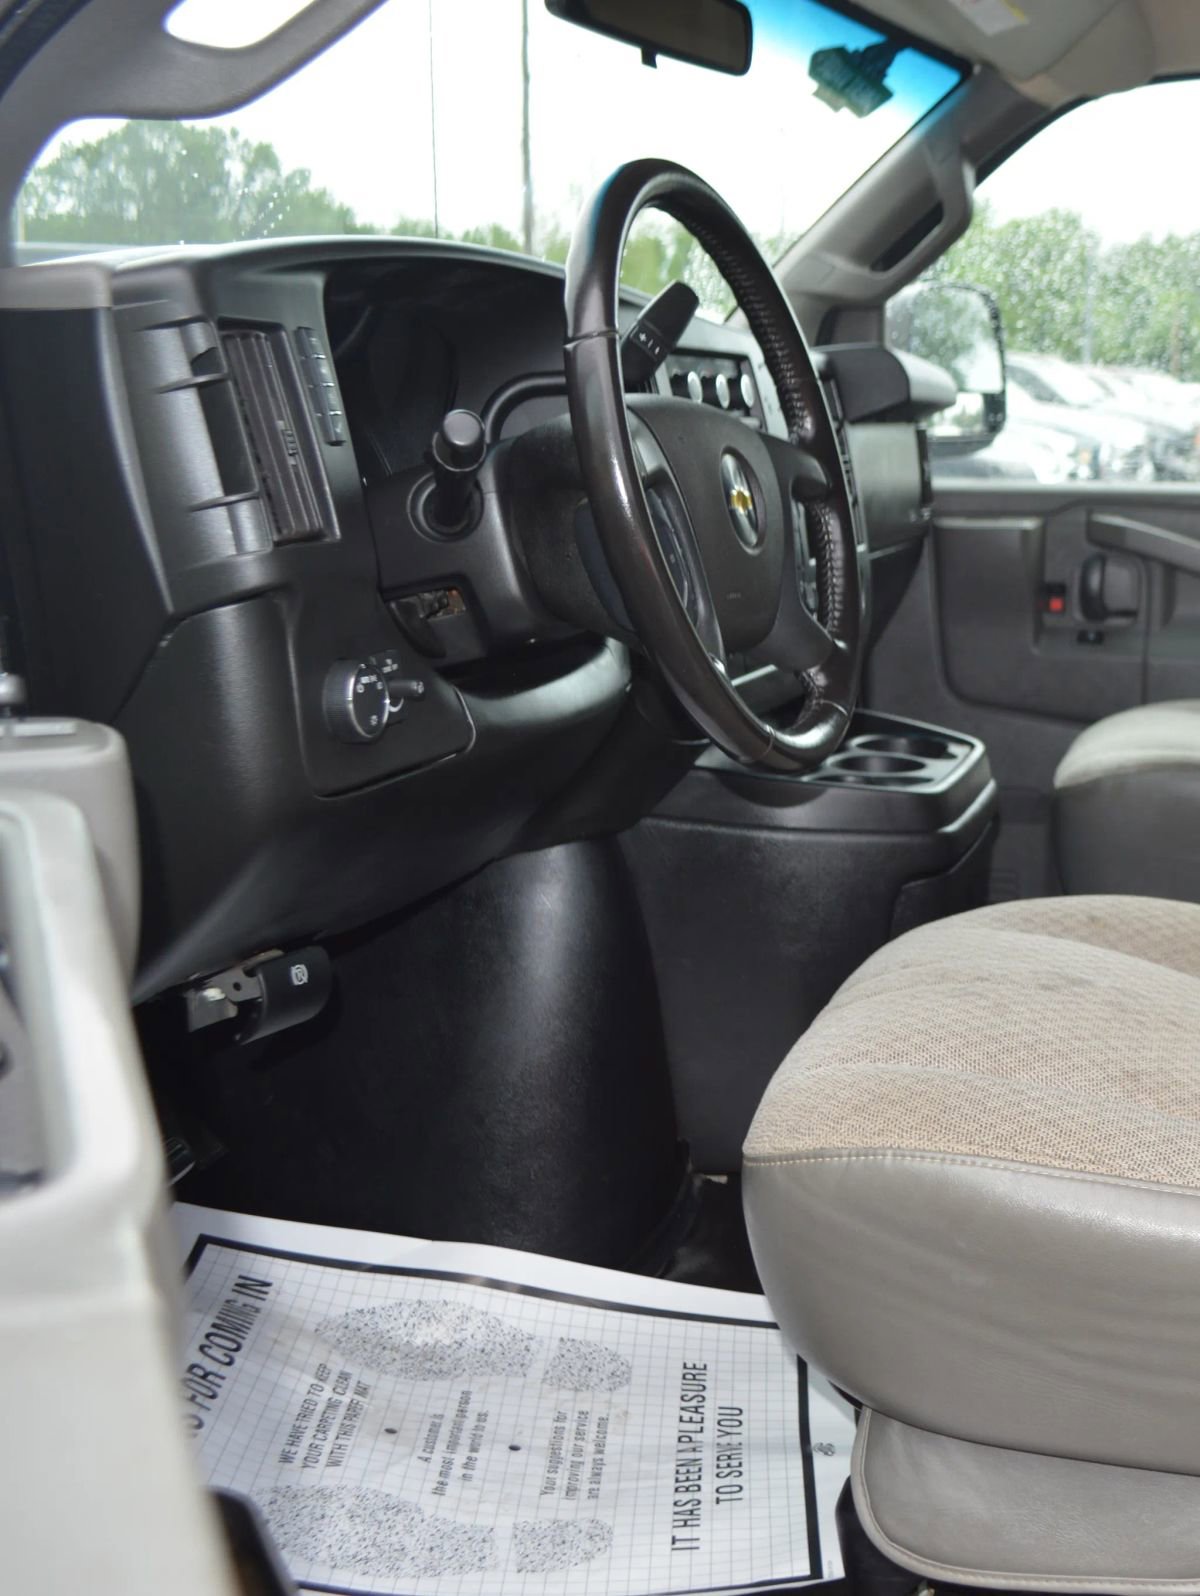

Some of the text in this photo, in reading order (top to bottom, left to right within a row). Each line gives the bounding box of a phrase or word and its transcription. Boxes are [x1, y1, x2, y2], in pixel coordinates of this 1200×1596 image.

[231, 1274, 273, 1302] IN
[198, 1299, 262, 1367] COMING
[183, 1363, 227, 1412] FOR
[307, 1383, 325, 1398] TO
[296, 1398, 319, 1423] TRIED
[455, 1390, 473, 1419] person
[300, 1369, 352, 1470] YOUR CARPETING CLEAN
[335, 1422, 357, 1442] THIS
[573, 1410, 589, 1442] service
[285, 1424, 309, 1448] HAVE
[278, 1448, 298, 1464] WE
[326, 1443, 349, 1468] WITH
[417, 1456, 432, 1464] A
[539, 1410, 568, 1496] Your suggestions for
[571, 1443, 584, 1458] our
[671, 1361, 707, 1551] IT HAS BEEN A PLEASURE
[716, 1406, 743, 1505] TO SERVE YOU
[439, 1456, 455, 1479] most
[461, 1456, 478, 1471] the
[587, 1457, 606, 1486] always
[431, 1480, 449, 1497] the
[457, 1473, 473, 1482] in
[587, 1487, 600, 1500] are
